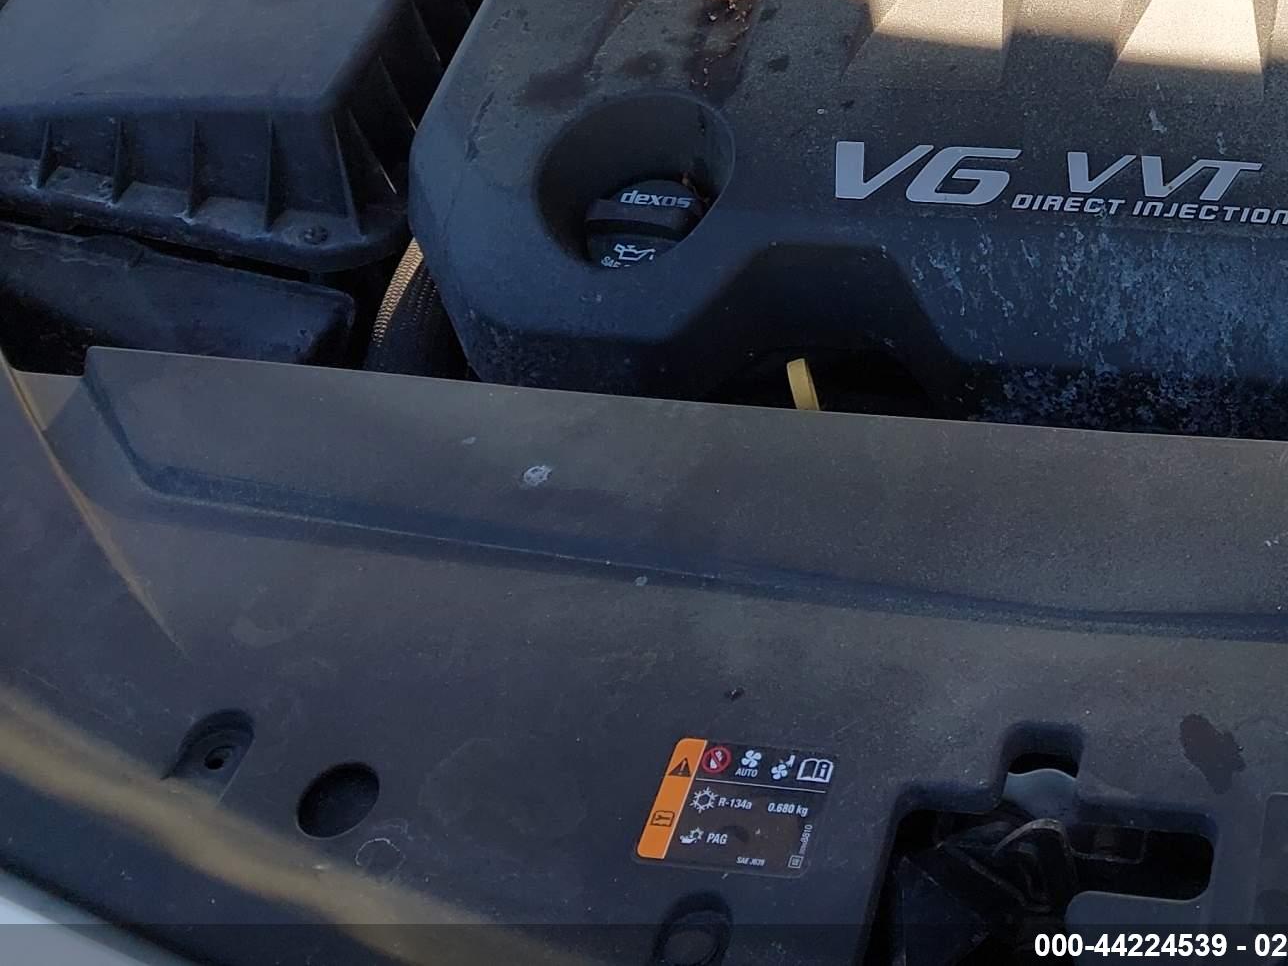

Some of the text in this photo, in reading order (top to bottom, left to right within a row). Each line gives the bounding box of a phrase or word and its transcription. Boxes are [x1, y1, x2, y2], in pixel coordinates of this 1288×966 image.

[836, 141, 1263, 205] V6 VVT
[620, 189, 696, 209] dexos
[1012, 193, 1126, 215] DIRECT
[735, 767, 758, 778] AUTO
[718, 797, 753, 810] R-134a
[767, 802, 809, 817] 0.680 kg
[706, 833, 728, 845] PAG
